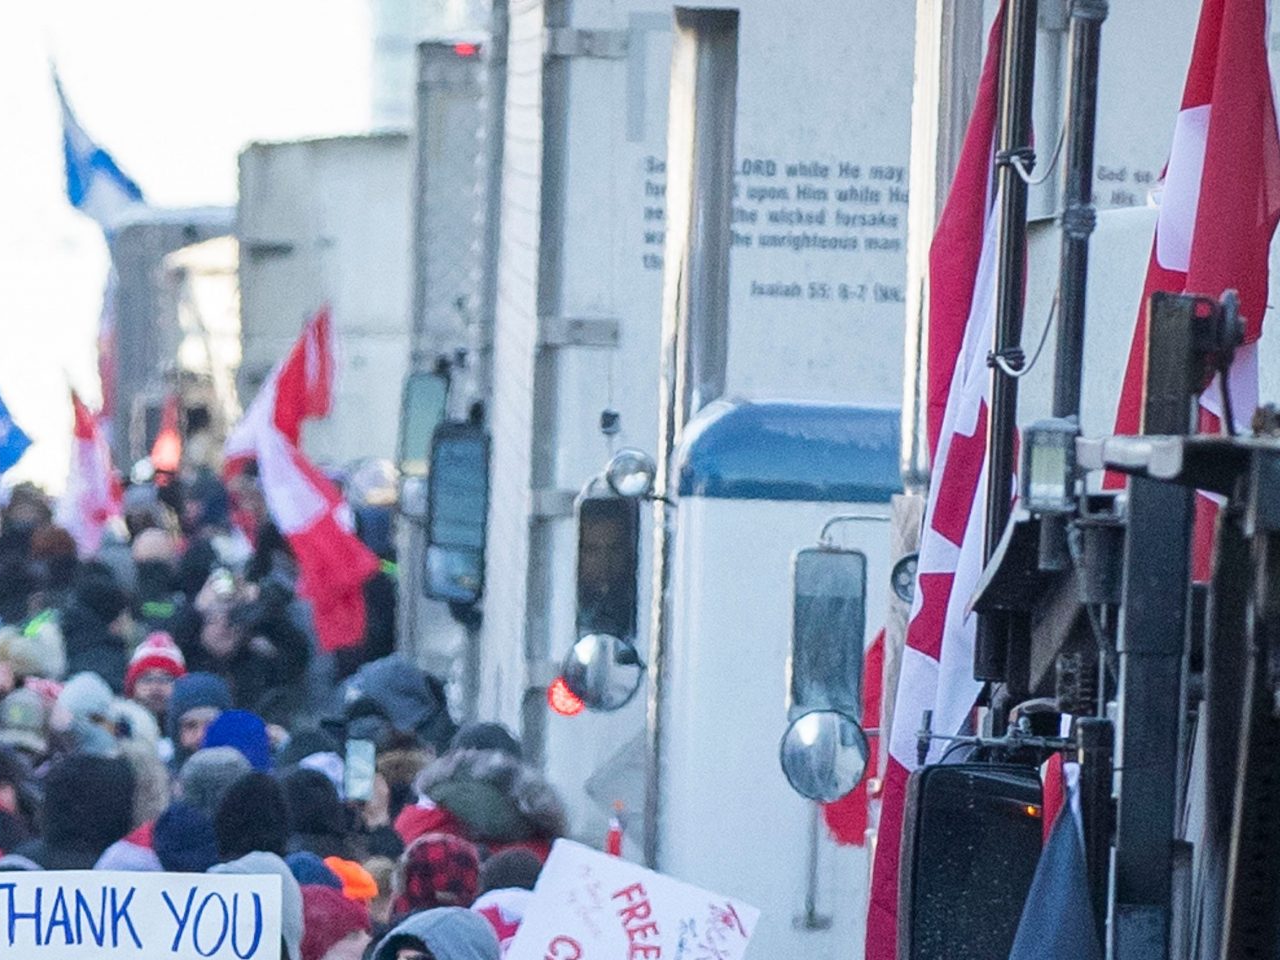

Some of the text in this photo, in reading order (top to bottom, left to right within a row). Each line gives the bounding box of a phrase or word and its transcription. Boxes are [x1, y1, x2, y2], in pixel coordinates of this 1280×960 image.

[838, 162, 861, 180] He
[868, 166, 905, 183] may
[796, 185, 828, 202] Him
[767, 206, 825, 226] wicked
[835, 208, 898, 228] forsake
[759, 232, 858, 251] unrighteous
[864, 238, 901, 251] man
[751, 280, 802, 298] Isaiah
[161, 885, 263, 960] YOU
